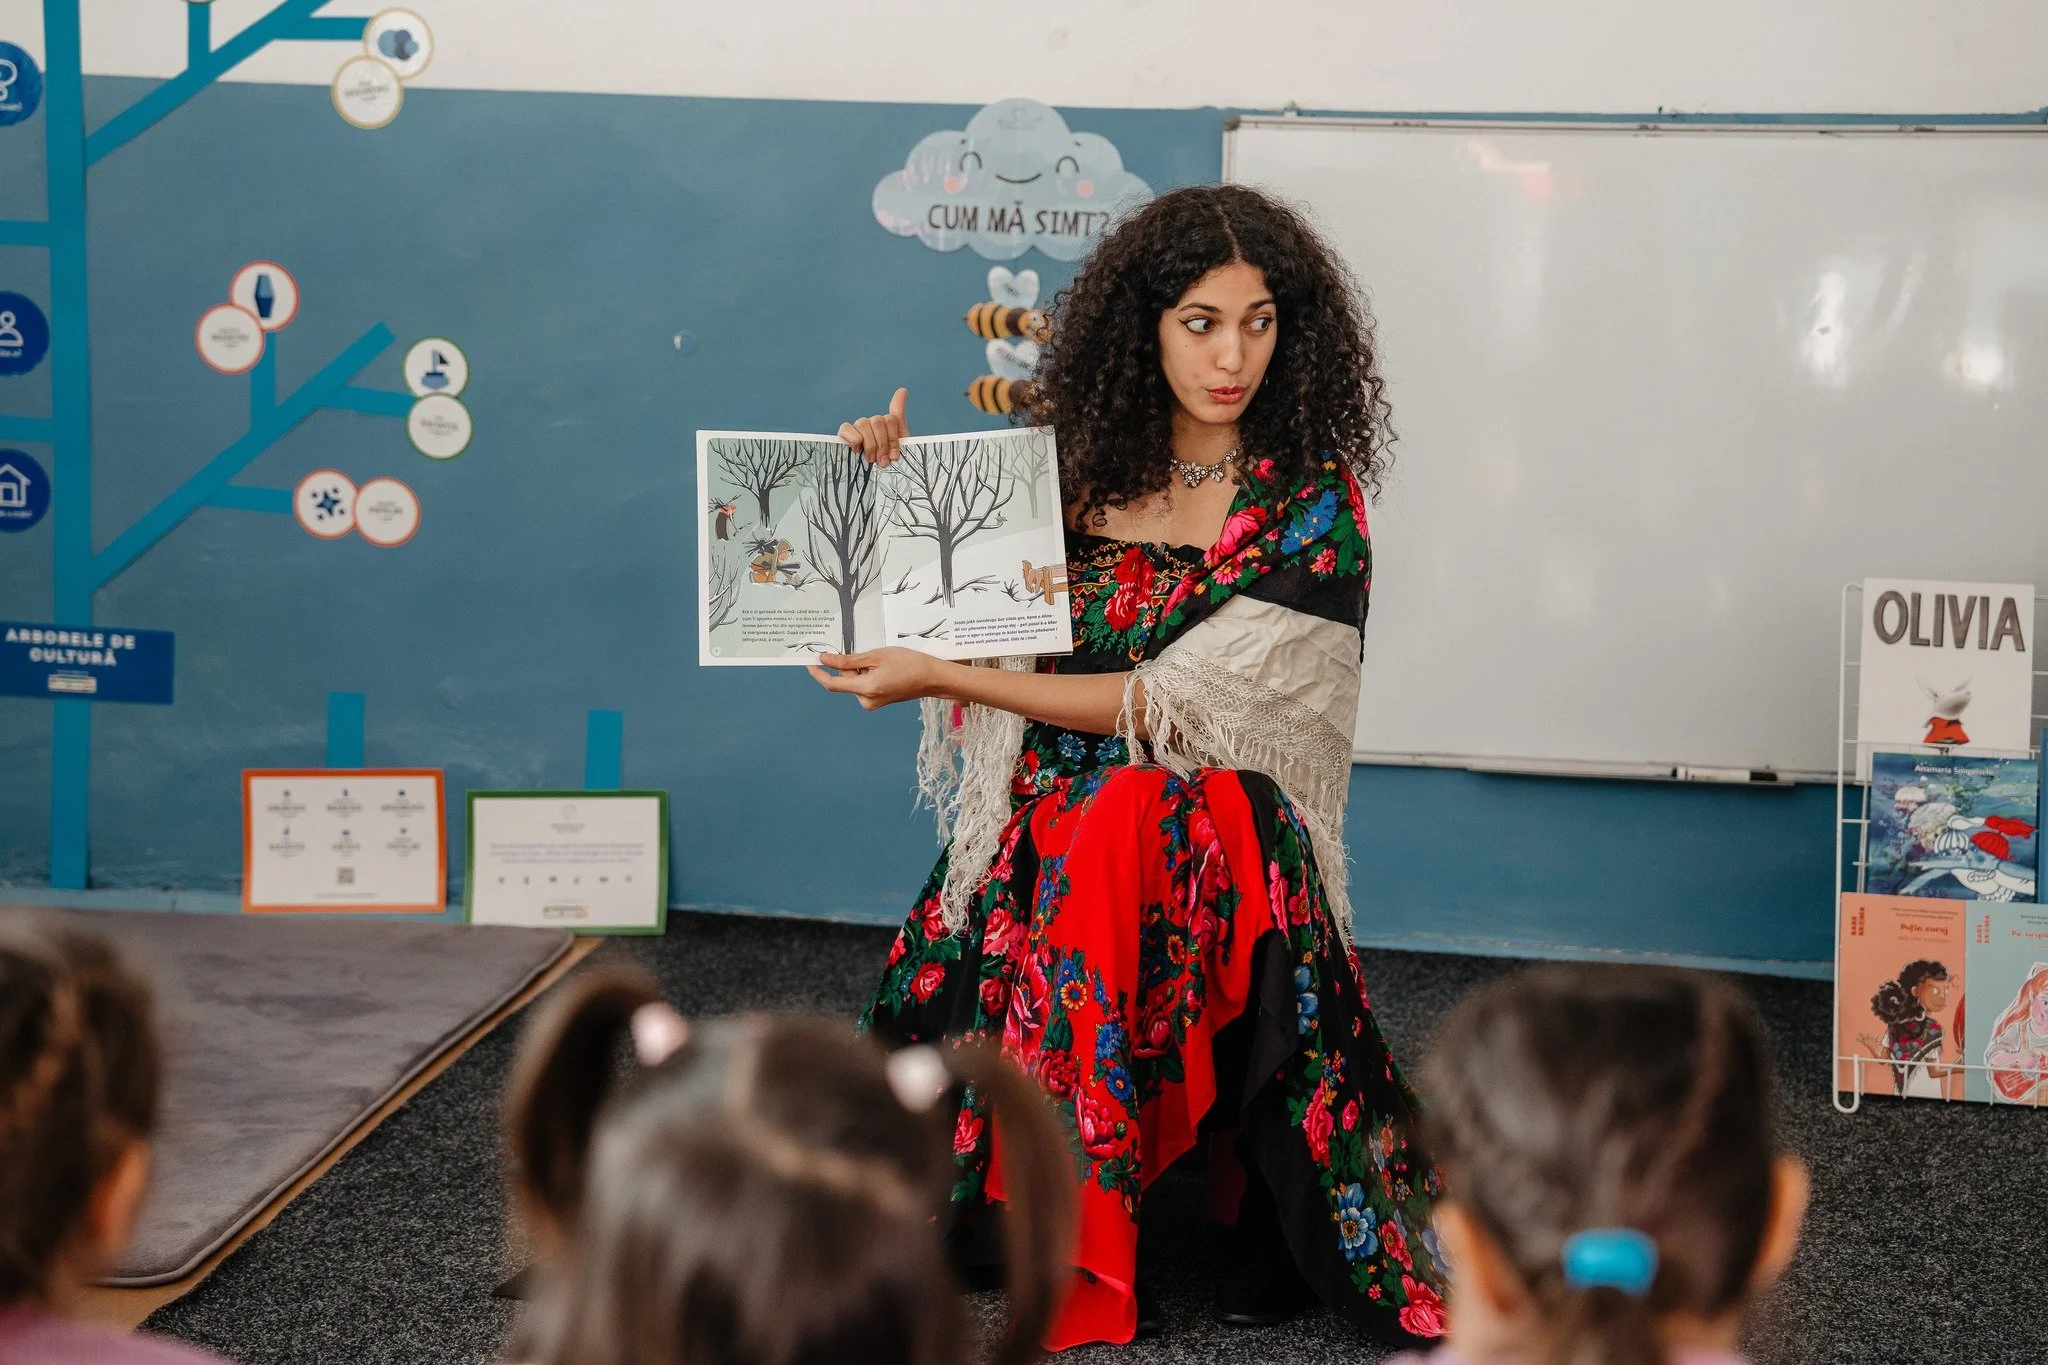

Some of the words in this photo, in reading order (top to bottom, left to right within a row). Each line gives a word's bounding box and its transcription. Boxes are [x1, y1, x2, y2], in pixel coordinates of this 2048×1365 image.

[928, 204, 979, 232] CUM
[987, 200, 1026, 234] MĂ
[1872, 589, 2026, 652] OLIVIA
[5, 627, 104, 648] ARBORELE
[109, 633, 136, 650] DE
[28, 646, 117, 667] CULTURĂ
[1914, 764, 1952, 774] Anamaria
